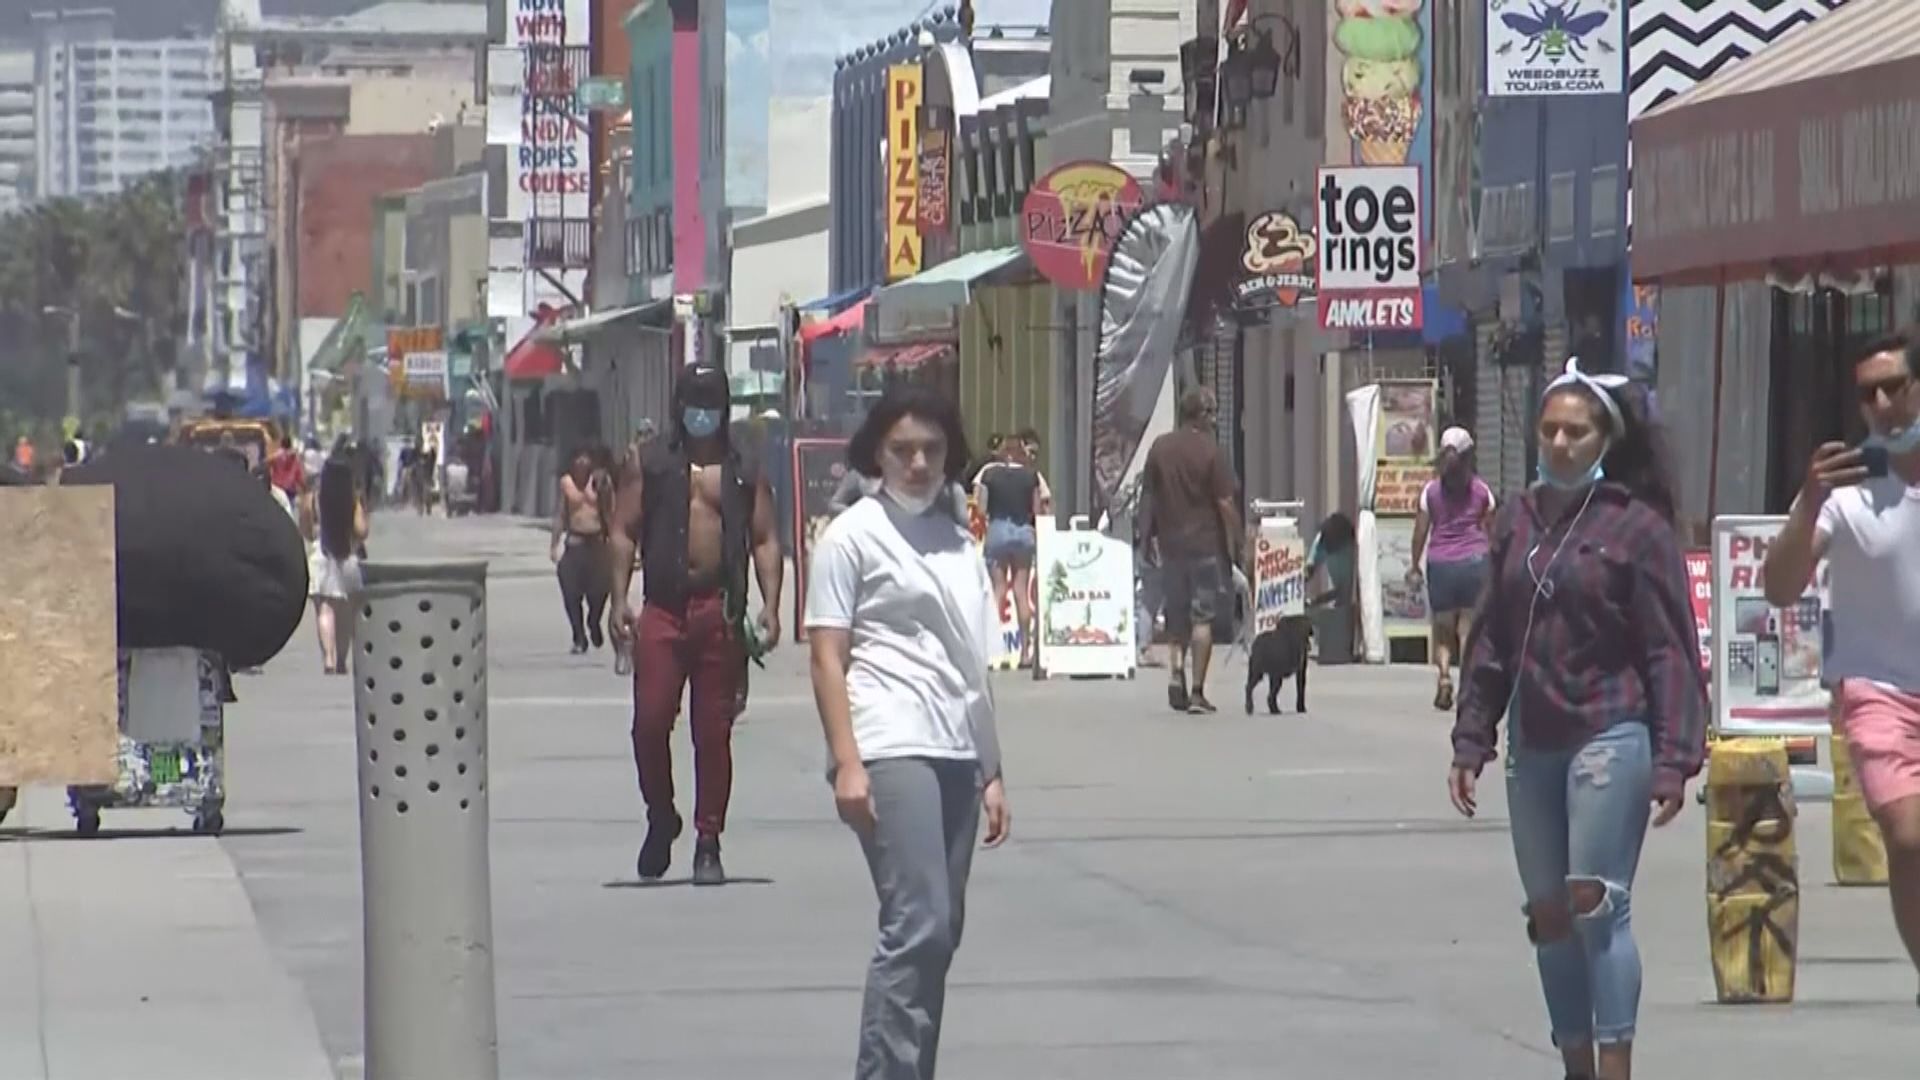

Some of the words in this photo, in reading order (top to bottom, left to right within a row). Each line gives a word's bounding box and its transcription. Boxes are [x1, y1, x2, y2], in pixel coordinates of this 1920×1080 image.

[1504, 81, 1605, 91] TOURS.COM
[1508, 68, 1600, 79] WEEDBUZZ
[518, 145, 579, 168] ROPES
[518, 172, 589, 194] COURSE
[894, 79, 916, 265] PIZZA
[1320, 174, 1416, 235] toe
[1325, 235, 1416, 283] rings
[1325, 297, 1414, 327] ANKLETS
